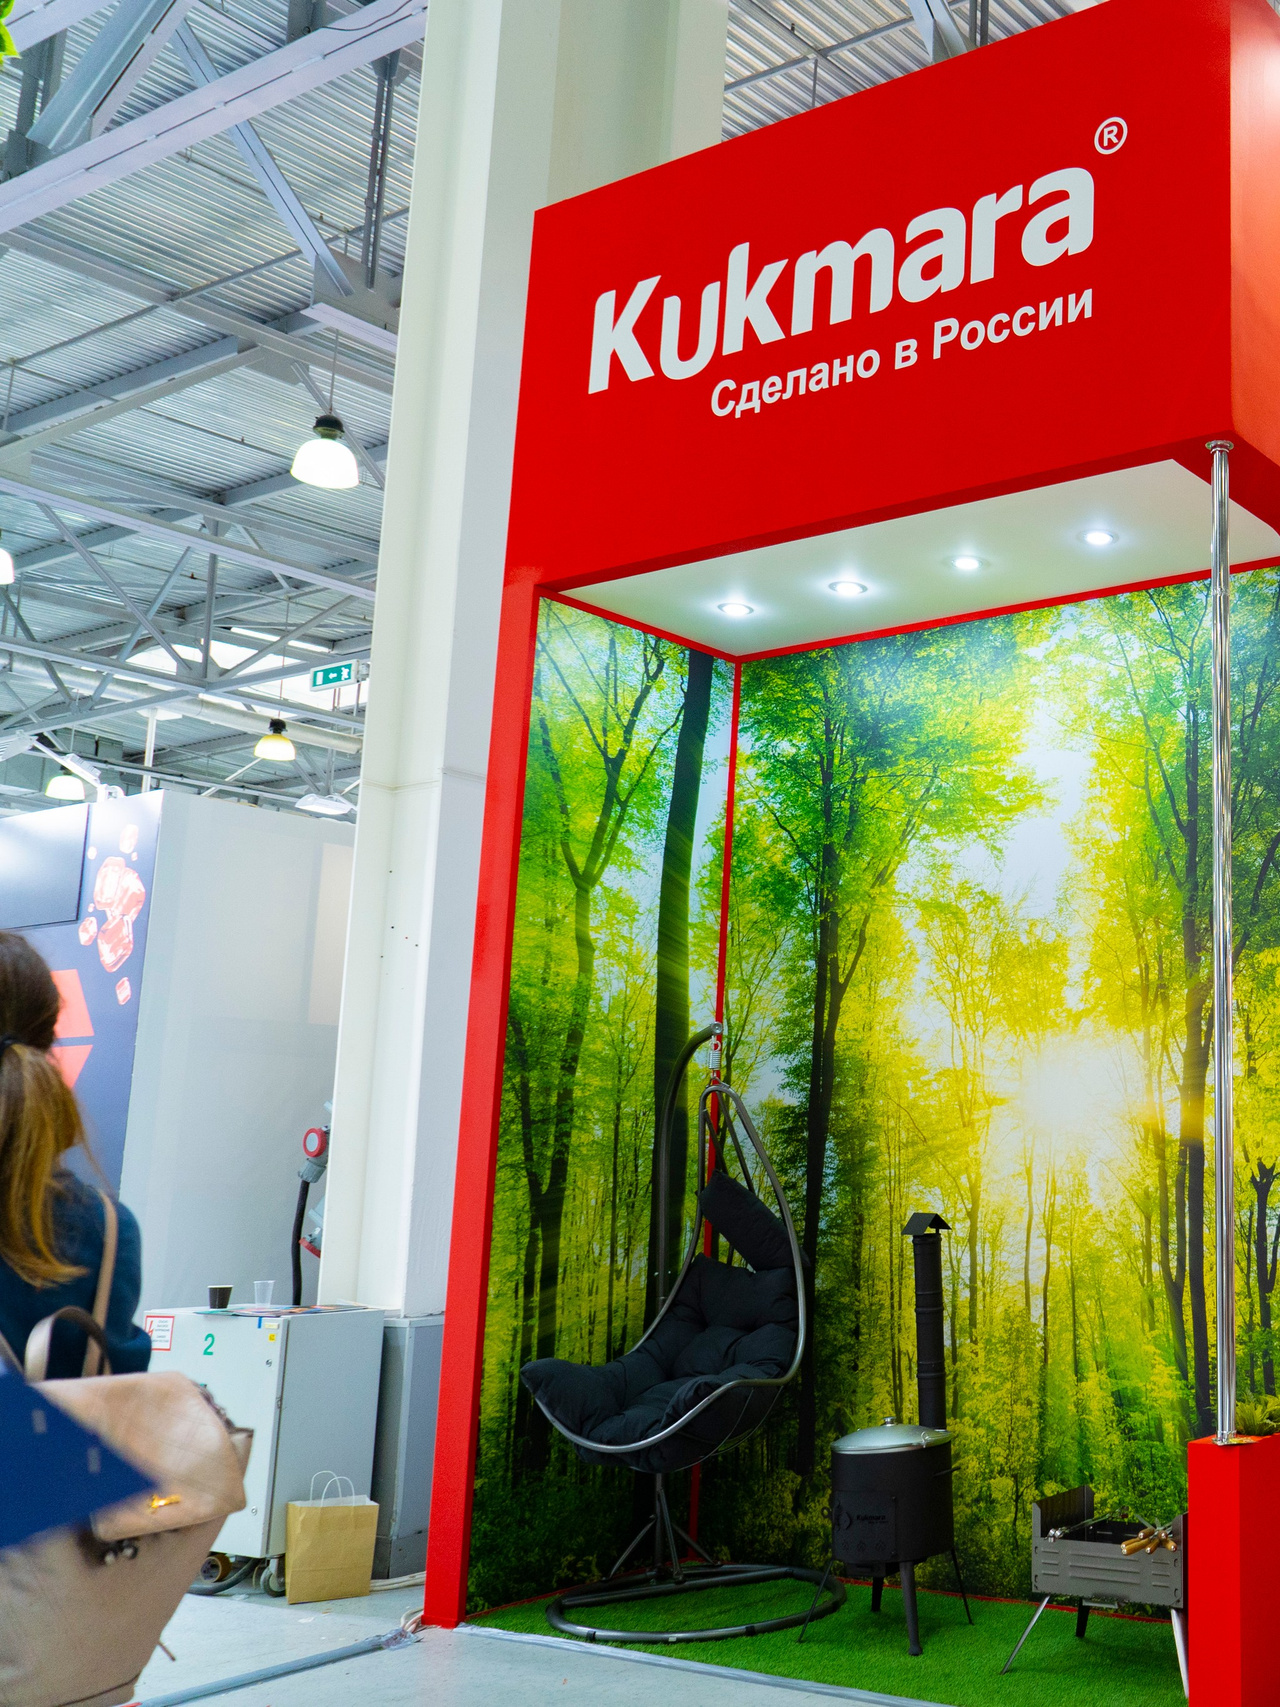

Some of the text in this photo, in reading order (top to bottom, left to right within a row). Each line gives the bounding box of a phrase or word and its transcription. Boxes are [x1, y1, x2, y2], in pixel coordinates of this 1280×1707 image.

[588, 167, 1095, 394] Kukmara
[710, 287, 1094, 419] Сделано в России
[203, 1333, 215, 1355] 2
